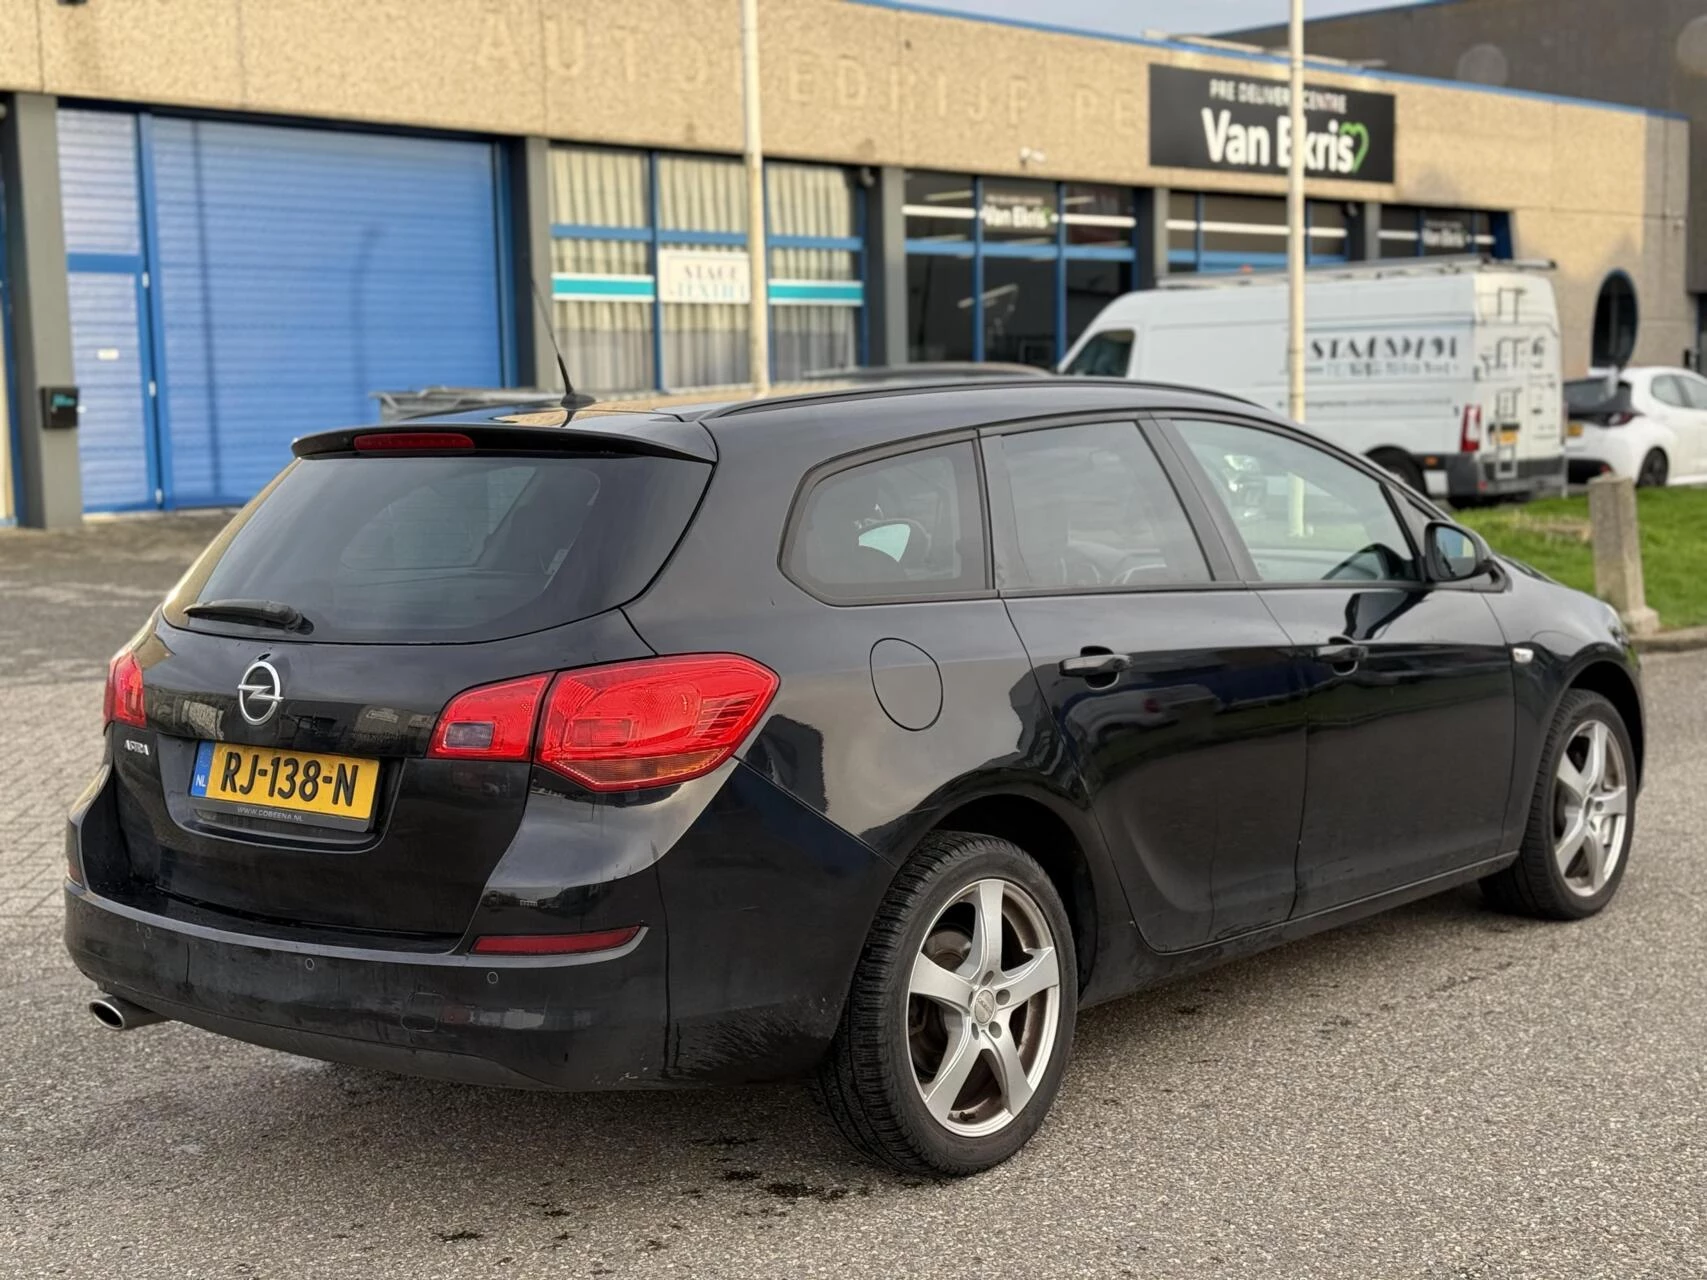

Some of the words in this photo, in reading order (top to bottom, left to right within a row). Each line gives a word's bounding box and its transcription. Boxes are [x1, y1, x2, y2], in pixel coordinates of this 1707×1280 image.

[475, 8, 1031, 125] AUTOEDRIJF
[1209, 79, 1236, 102] PRE
[1238, 82, 1291, 107] DELIVER
[1301, 89, 1347, 114] CENTRE
[1201, 107, 1271, 166] Van
[1276, 115, 1355, 174] Ekris
[982, 204, 1011, 227] Van
[124, 739, 150, 756] ASTRA
[195, 775, 207, 787] NL
[220, 751, 359, 807] RJ-138-N
